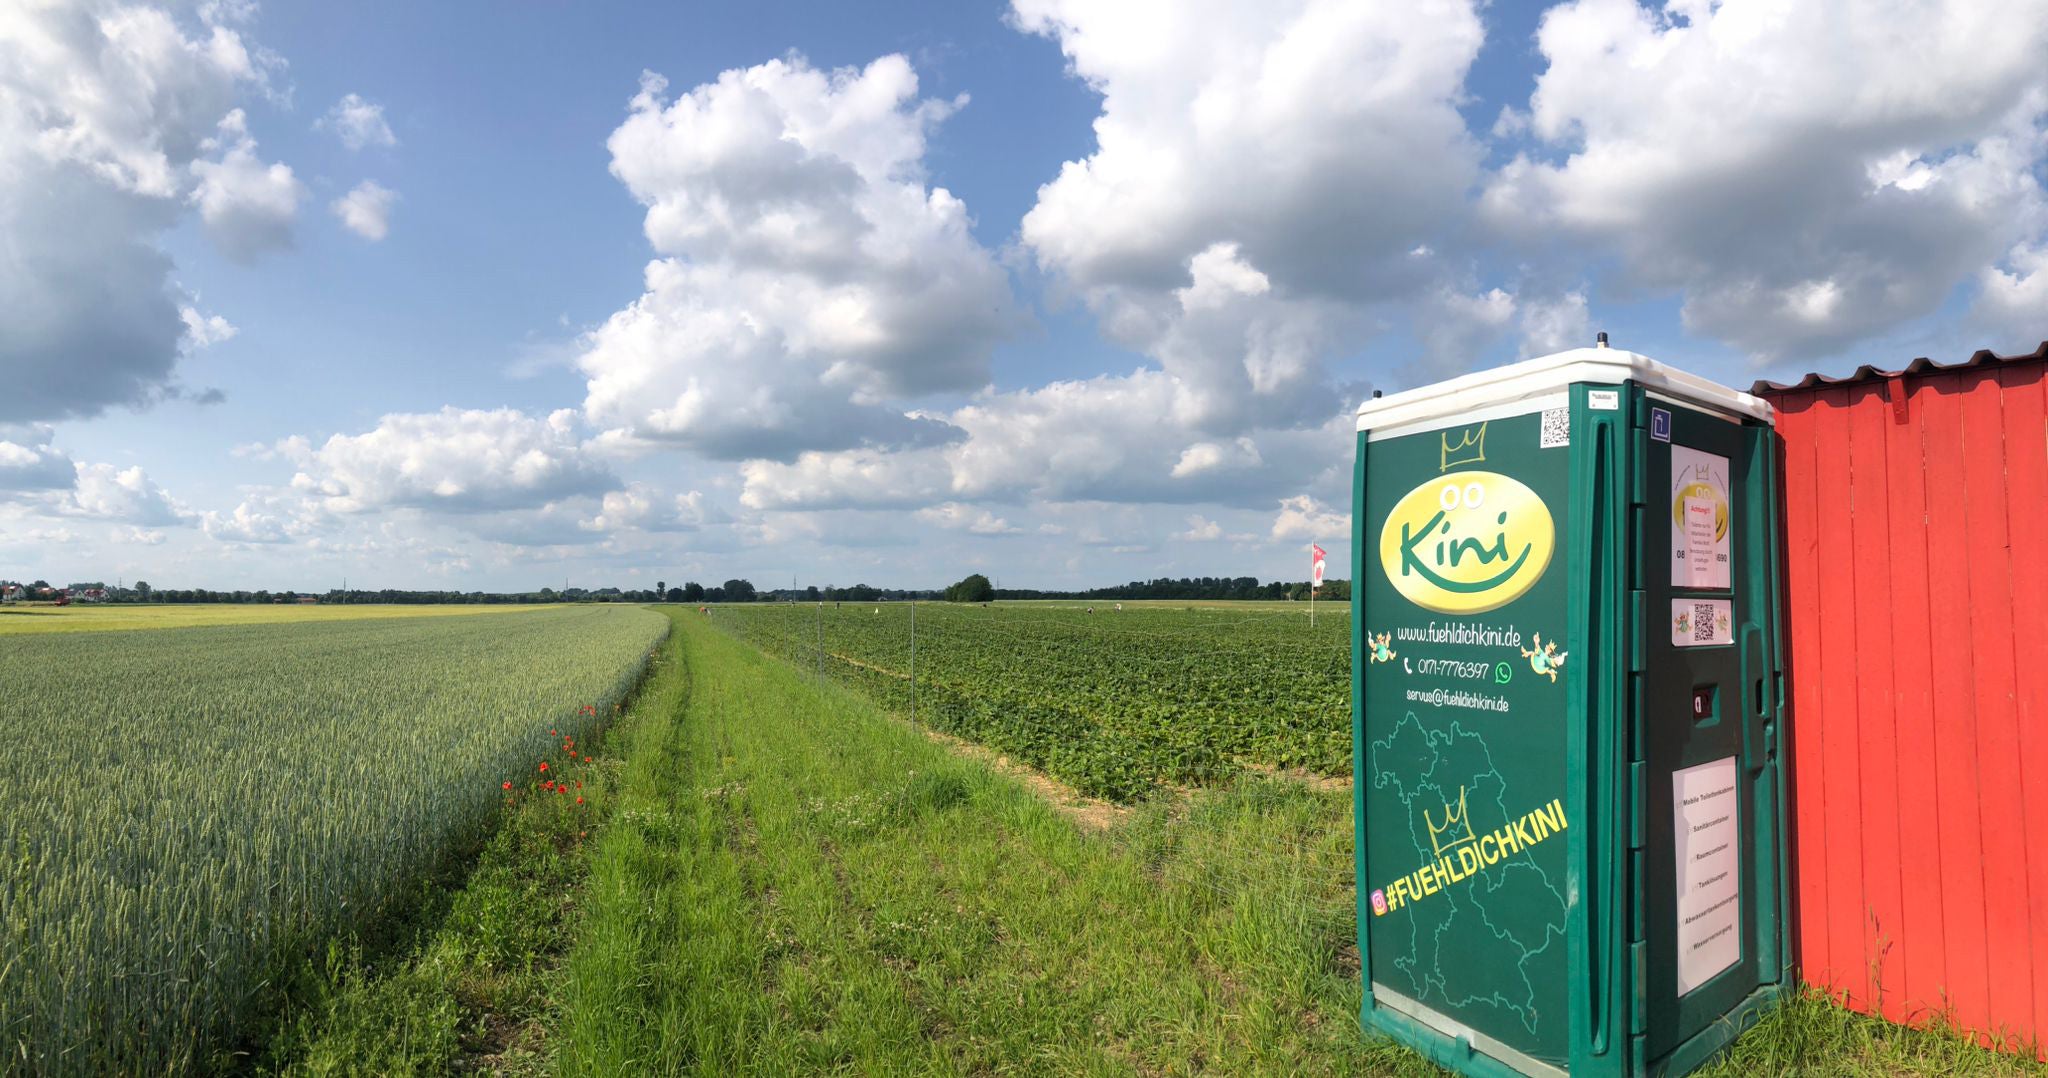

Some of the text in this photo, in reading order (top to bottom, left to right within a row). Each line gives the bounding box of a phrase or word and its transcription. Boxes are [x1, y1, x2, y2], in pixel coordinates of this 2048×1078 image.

[1400, 510, 1532, 593] Kini
[1397, 621, 1521, 647] www.fuehldichkini.de
[1418, 658, 1489, 680] 0171-7776397
[1406, 688, 1509, 712] servus@fuehldichkini.de
[1386, 798, 1568, 912] #FUEHLDICHKINI
